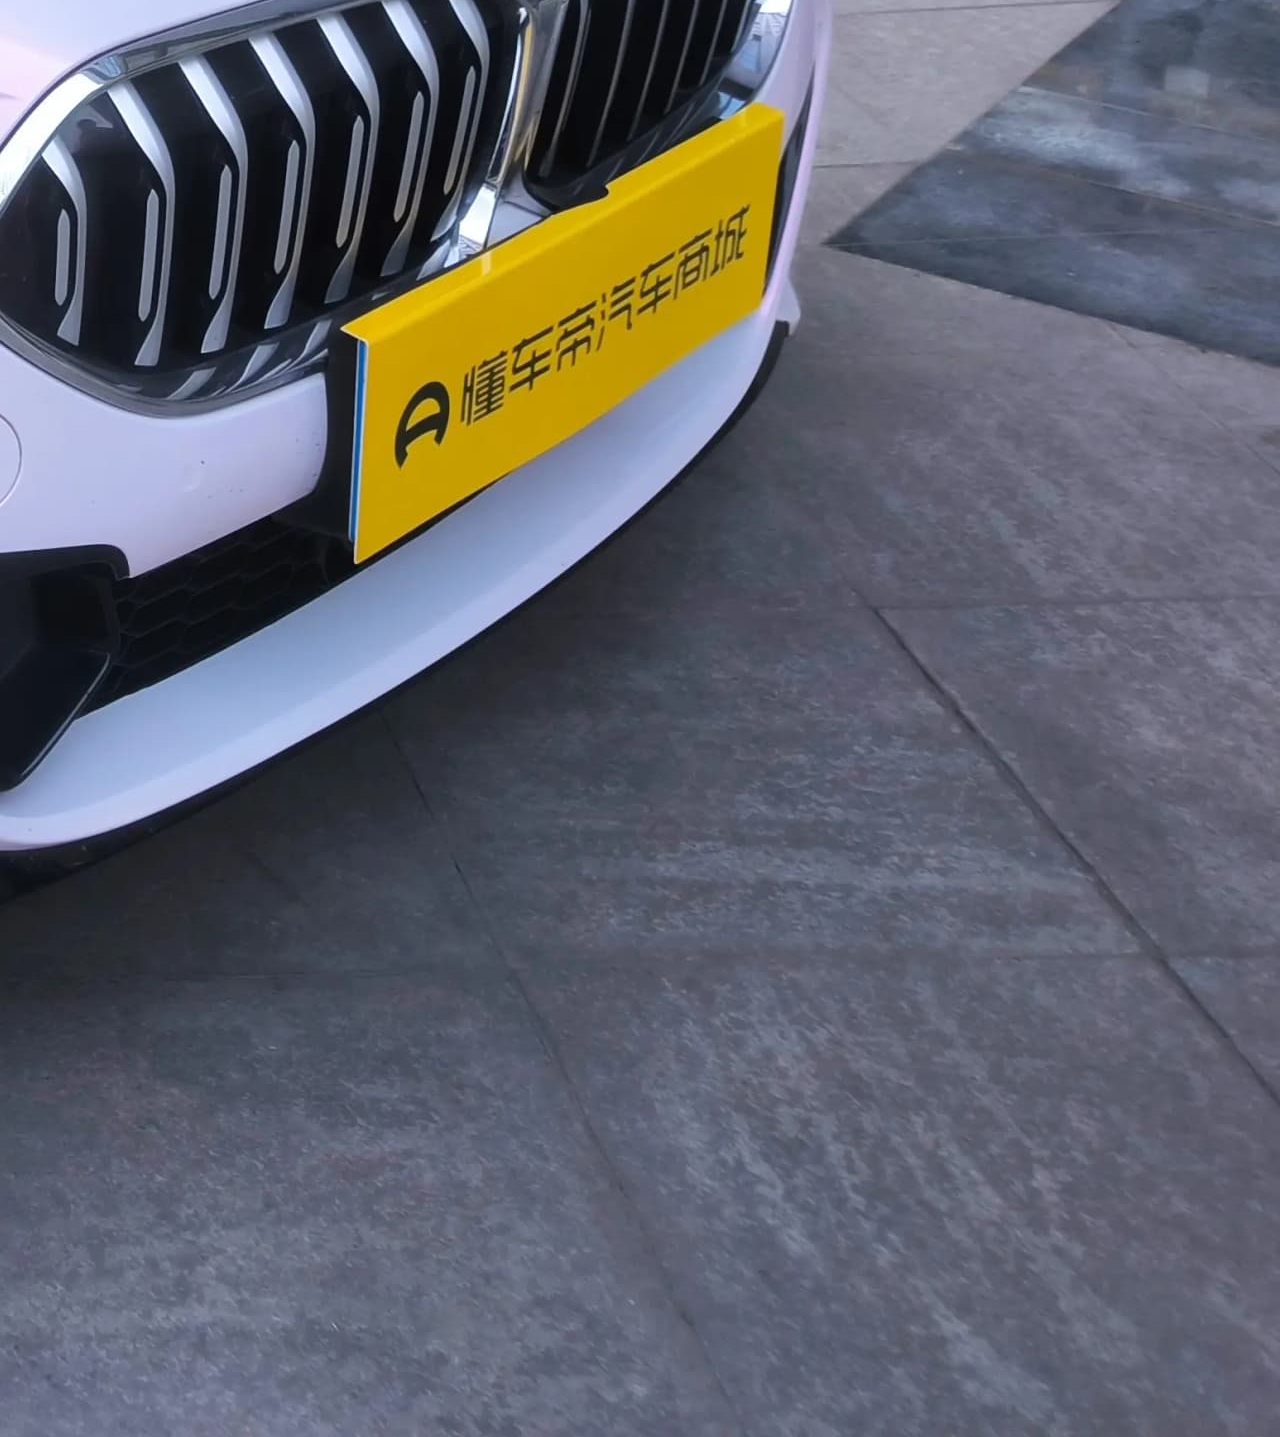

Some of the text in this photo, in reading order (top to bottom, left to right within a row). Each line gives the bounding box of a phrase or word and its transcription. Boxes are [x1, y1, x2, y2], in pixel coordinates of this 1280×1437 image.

[460, 204, 750, 426] 懂车帝汽车商城
